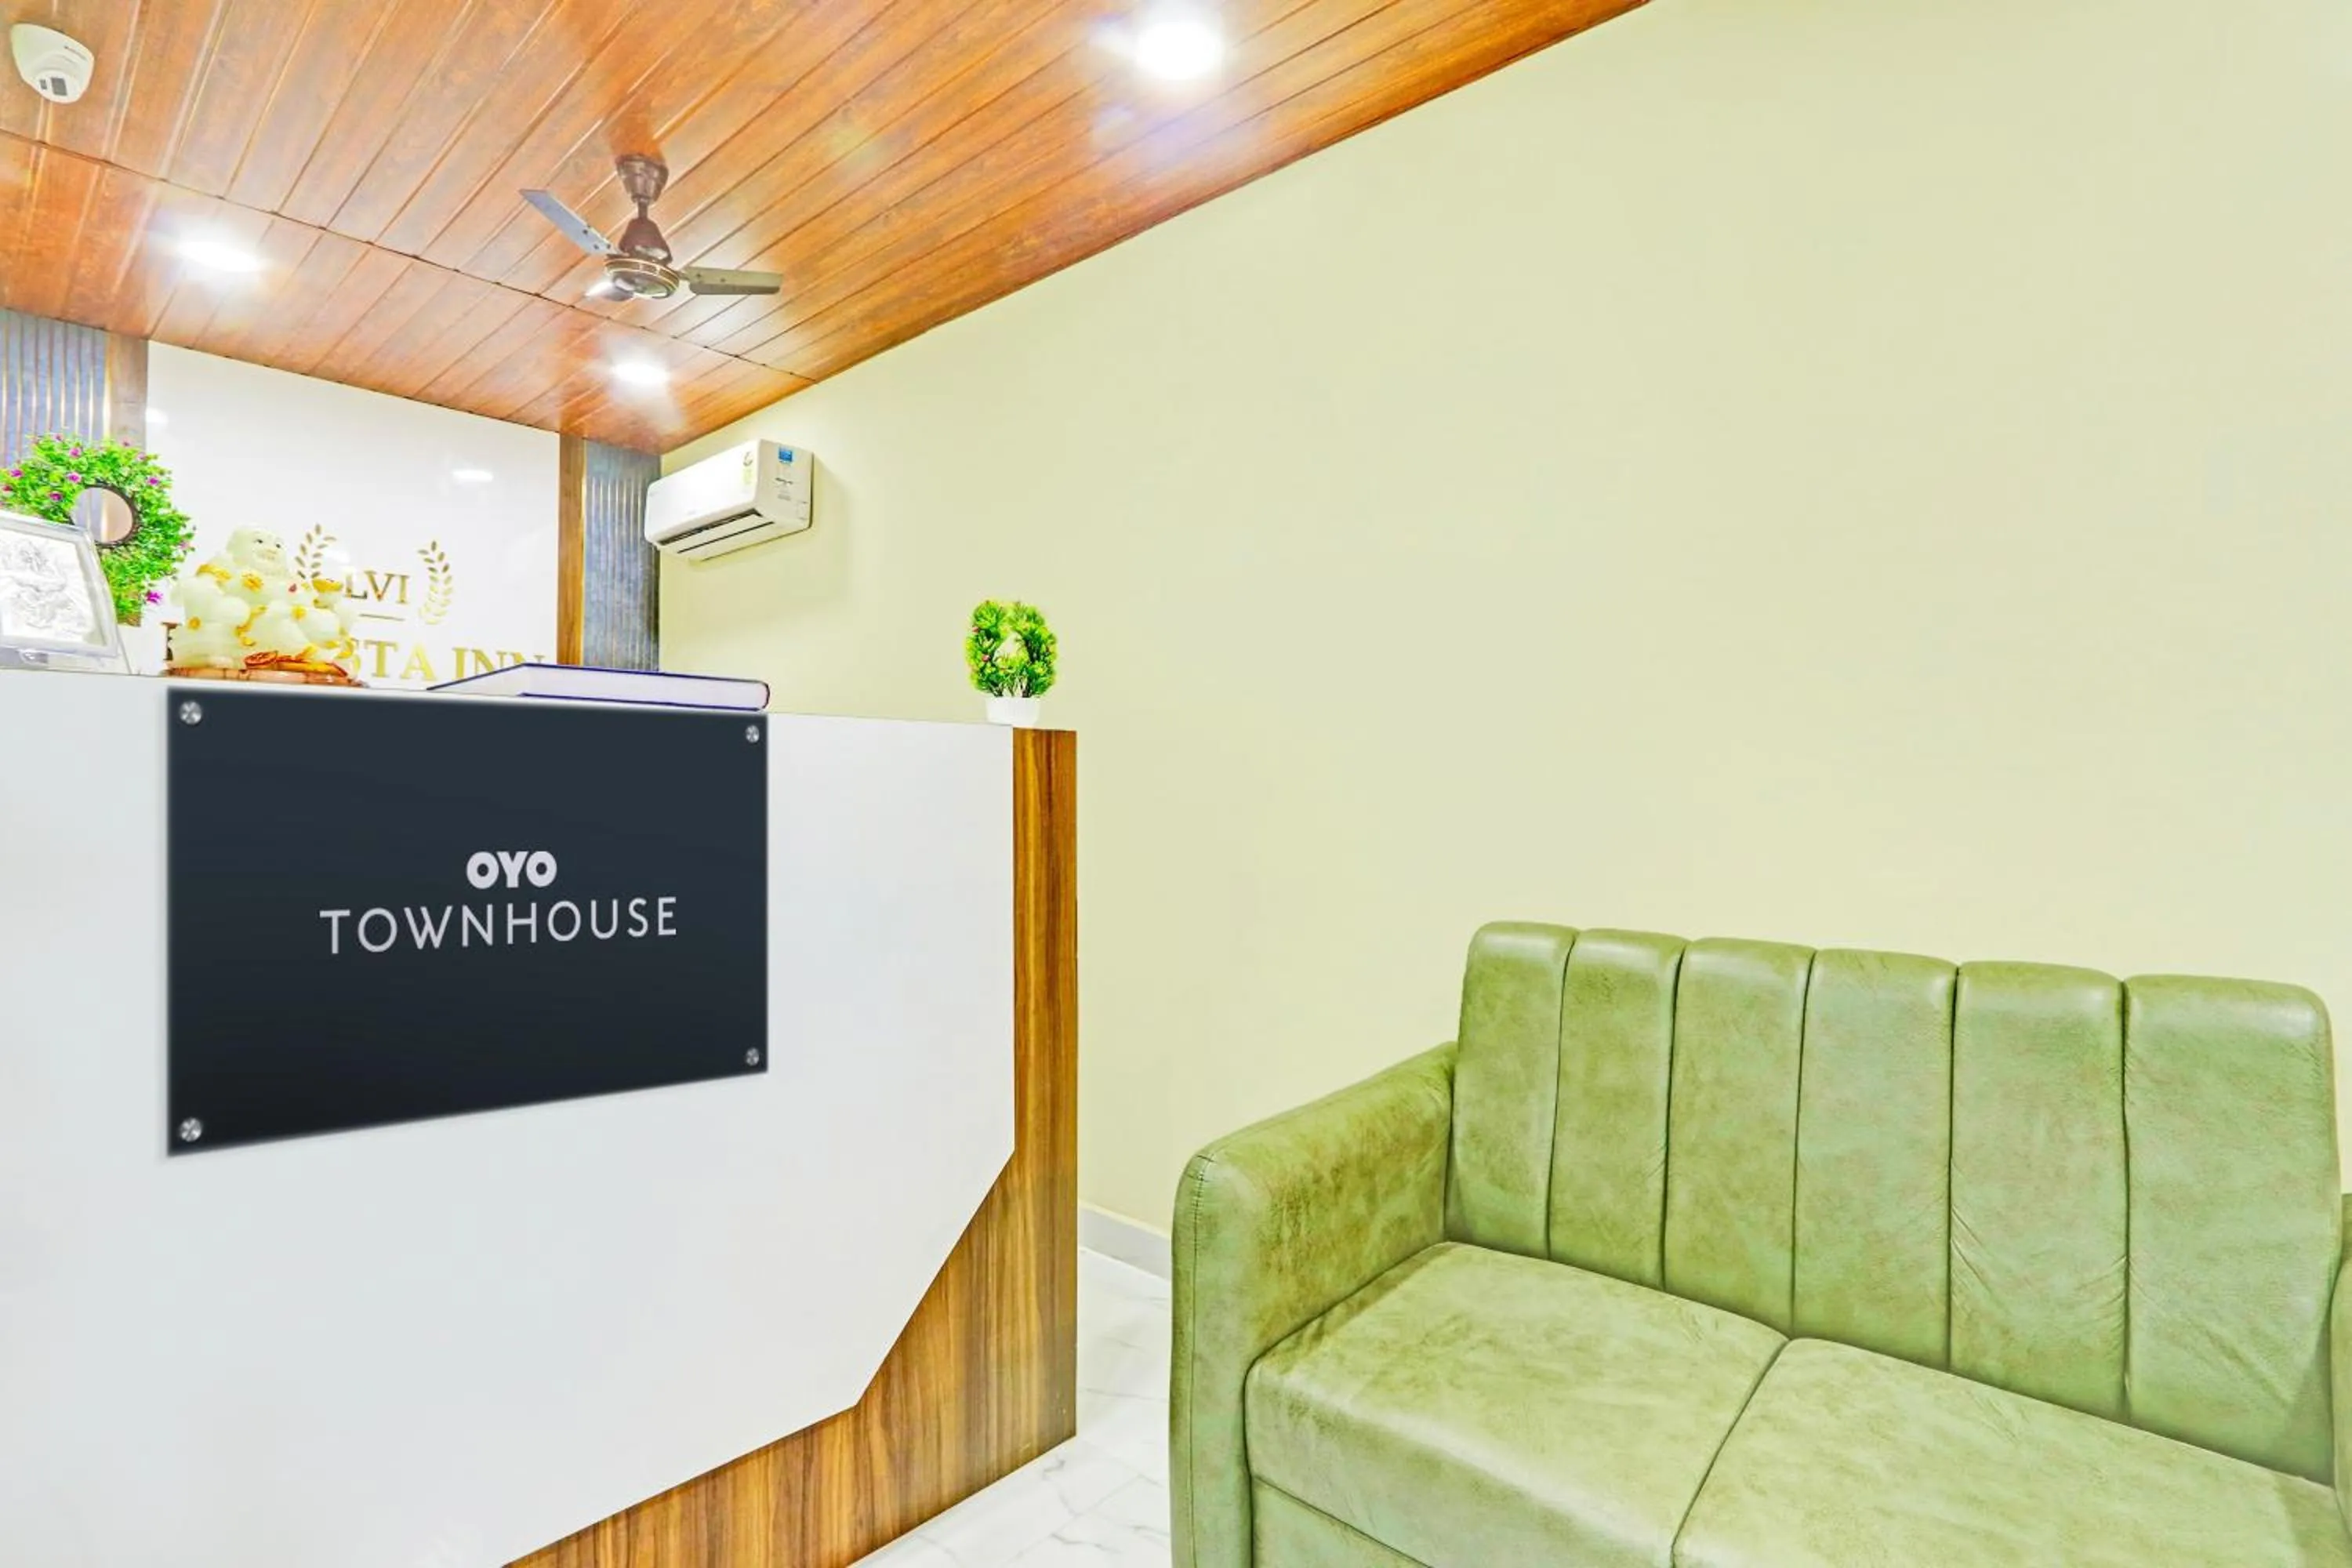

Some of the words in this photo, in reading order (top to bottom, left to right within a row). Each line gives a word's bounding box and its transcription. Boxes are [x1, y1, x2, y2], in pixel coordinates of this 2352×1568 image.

[452, 647, 546, 680] IN
[466, 851, 557, 889] OYO
[320, 897, 677, 954] TOWNHOUSE
